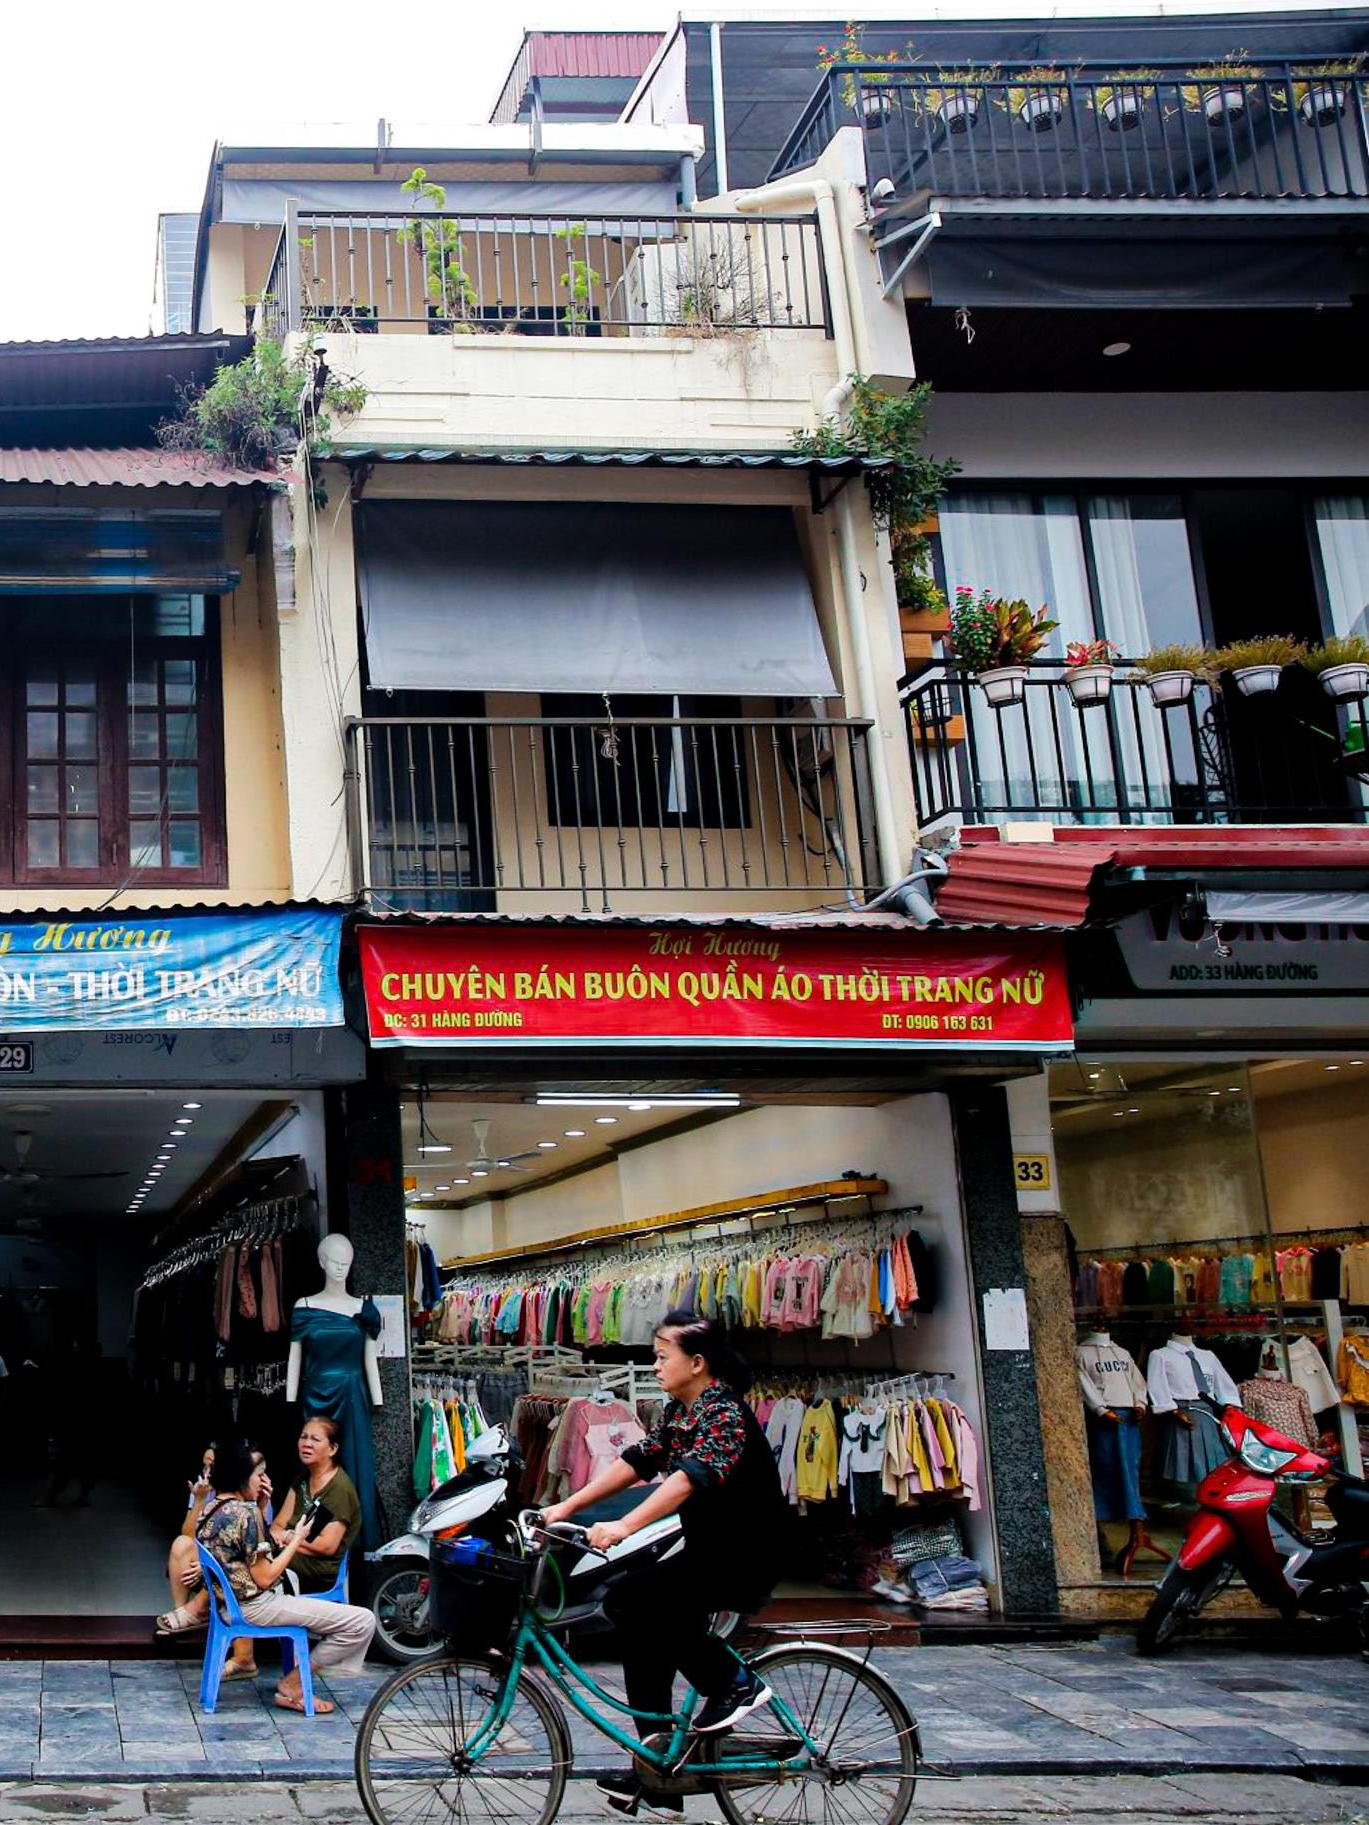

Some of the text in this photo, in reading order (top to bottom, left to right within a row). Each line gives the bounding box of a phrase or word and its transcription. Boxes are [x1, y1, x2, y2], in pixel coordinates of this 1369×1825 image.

[32, 922, 174, 956] Hương
[702, 931, 781, 961] Hương
[67, 962, 145, 1001] THỜI
[155, 968, 266, 1001] TRANG
[276, 961, 324, 998] NỮ
[380, 960, 1046, 1007] CHUYÊN BÁN BUÔN QUẦN ÁO THỜI TRANG NỮ
[1169, 961, 1319, 980] ADD: 33 HÀNG ĐƯỜNG
[383, 1009, 523, 1028] ĐC: 31 HÀNG ĐƯỜNG
[882, 1013, 994, 1032] ĐT: 0906 163 631
[1017, 1160, 1044, 1182] 33
